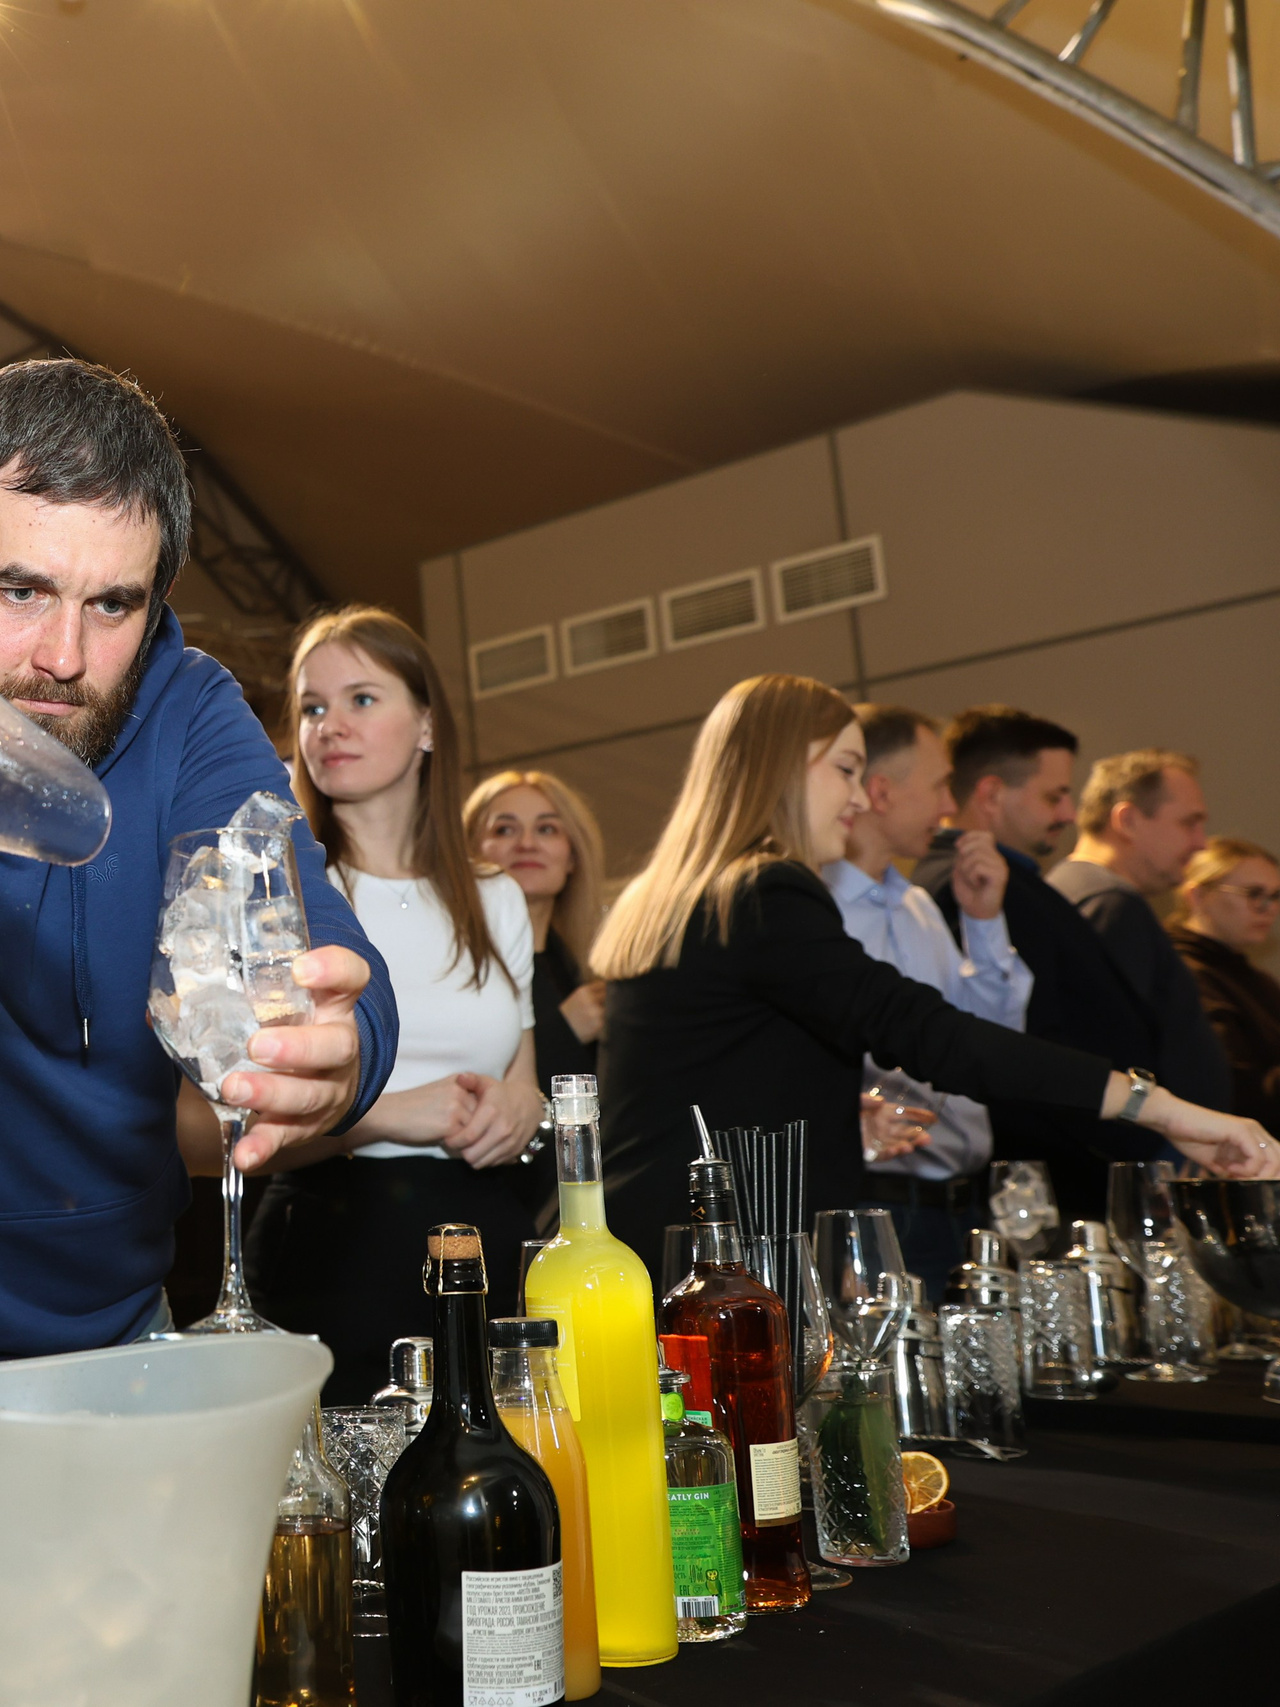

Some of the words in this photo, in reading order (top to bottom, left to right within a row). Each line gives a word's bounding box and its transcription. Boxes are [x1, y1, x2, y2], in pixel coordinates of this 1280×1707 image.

[667, 1493, 692, 1501] EATLY
[694, 1492, 710, 1500] GIN
[477, 1605, 497, 1616] УРОЖАЯ
